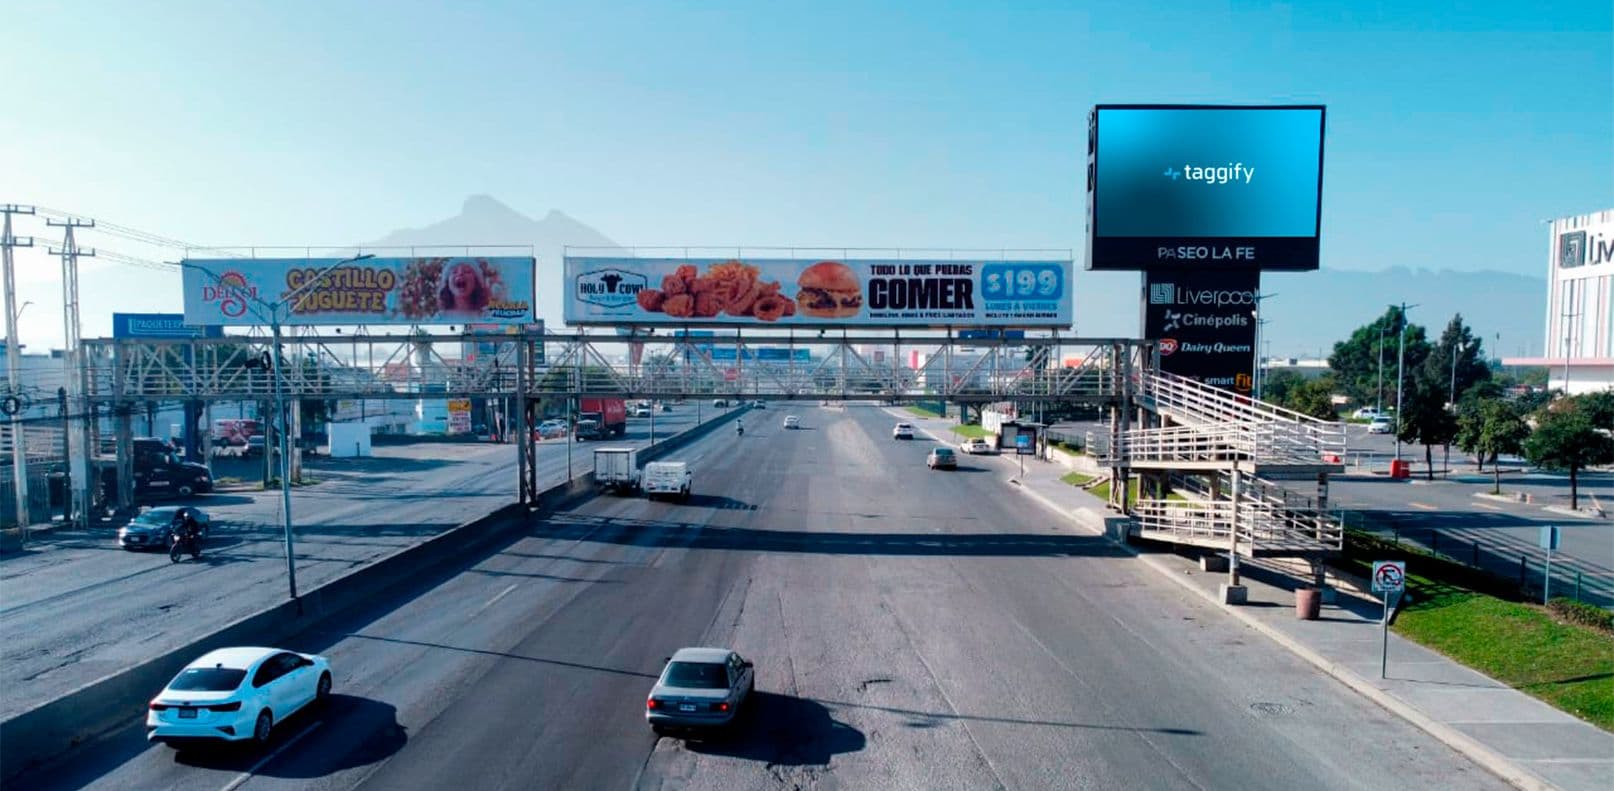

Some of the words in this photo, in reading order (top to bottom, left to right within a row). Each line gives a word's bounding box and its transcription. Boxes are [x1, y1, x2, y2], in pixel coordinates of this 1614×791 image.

[1184, 162, 1255, 184] taggify
[1158, 246, 1208, 260] PASEO
[1212, 247, 1233, 260] LA
[1236, 247, 1256, 260] FE
[870, 264, 896, 275] TODO
[899, 264, 911, 275] LO
[913, 264, 932, 276] QUE
[935, 264, 973, 275] PUEDAS
[287, 267, 396, 292] CASTILLO
[986, 269, 1057, 296] $199
[580, 283, 605, 299] HOLY
[868, 278, 975, 309] COMER
[288, 289, 387, 315] JUGUETE
[1182, 313, 1248, 329] Cinépolis
[1181, 342, 1212, 354] Dairy
[1213, 342, 1251, 353] Queen
[1204, 376, 1235, 386] smart
